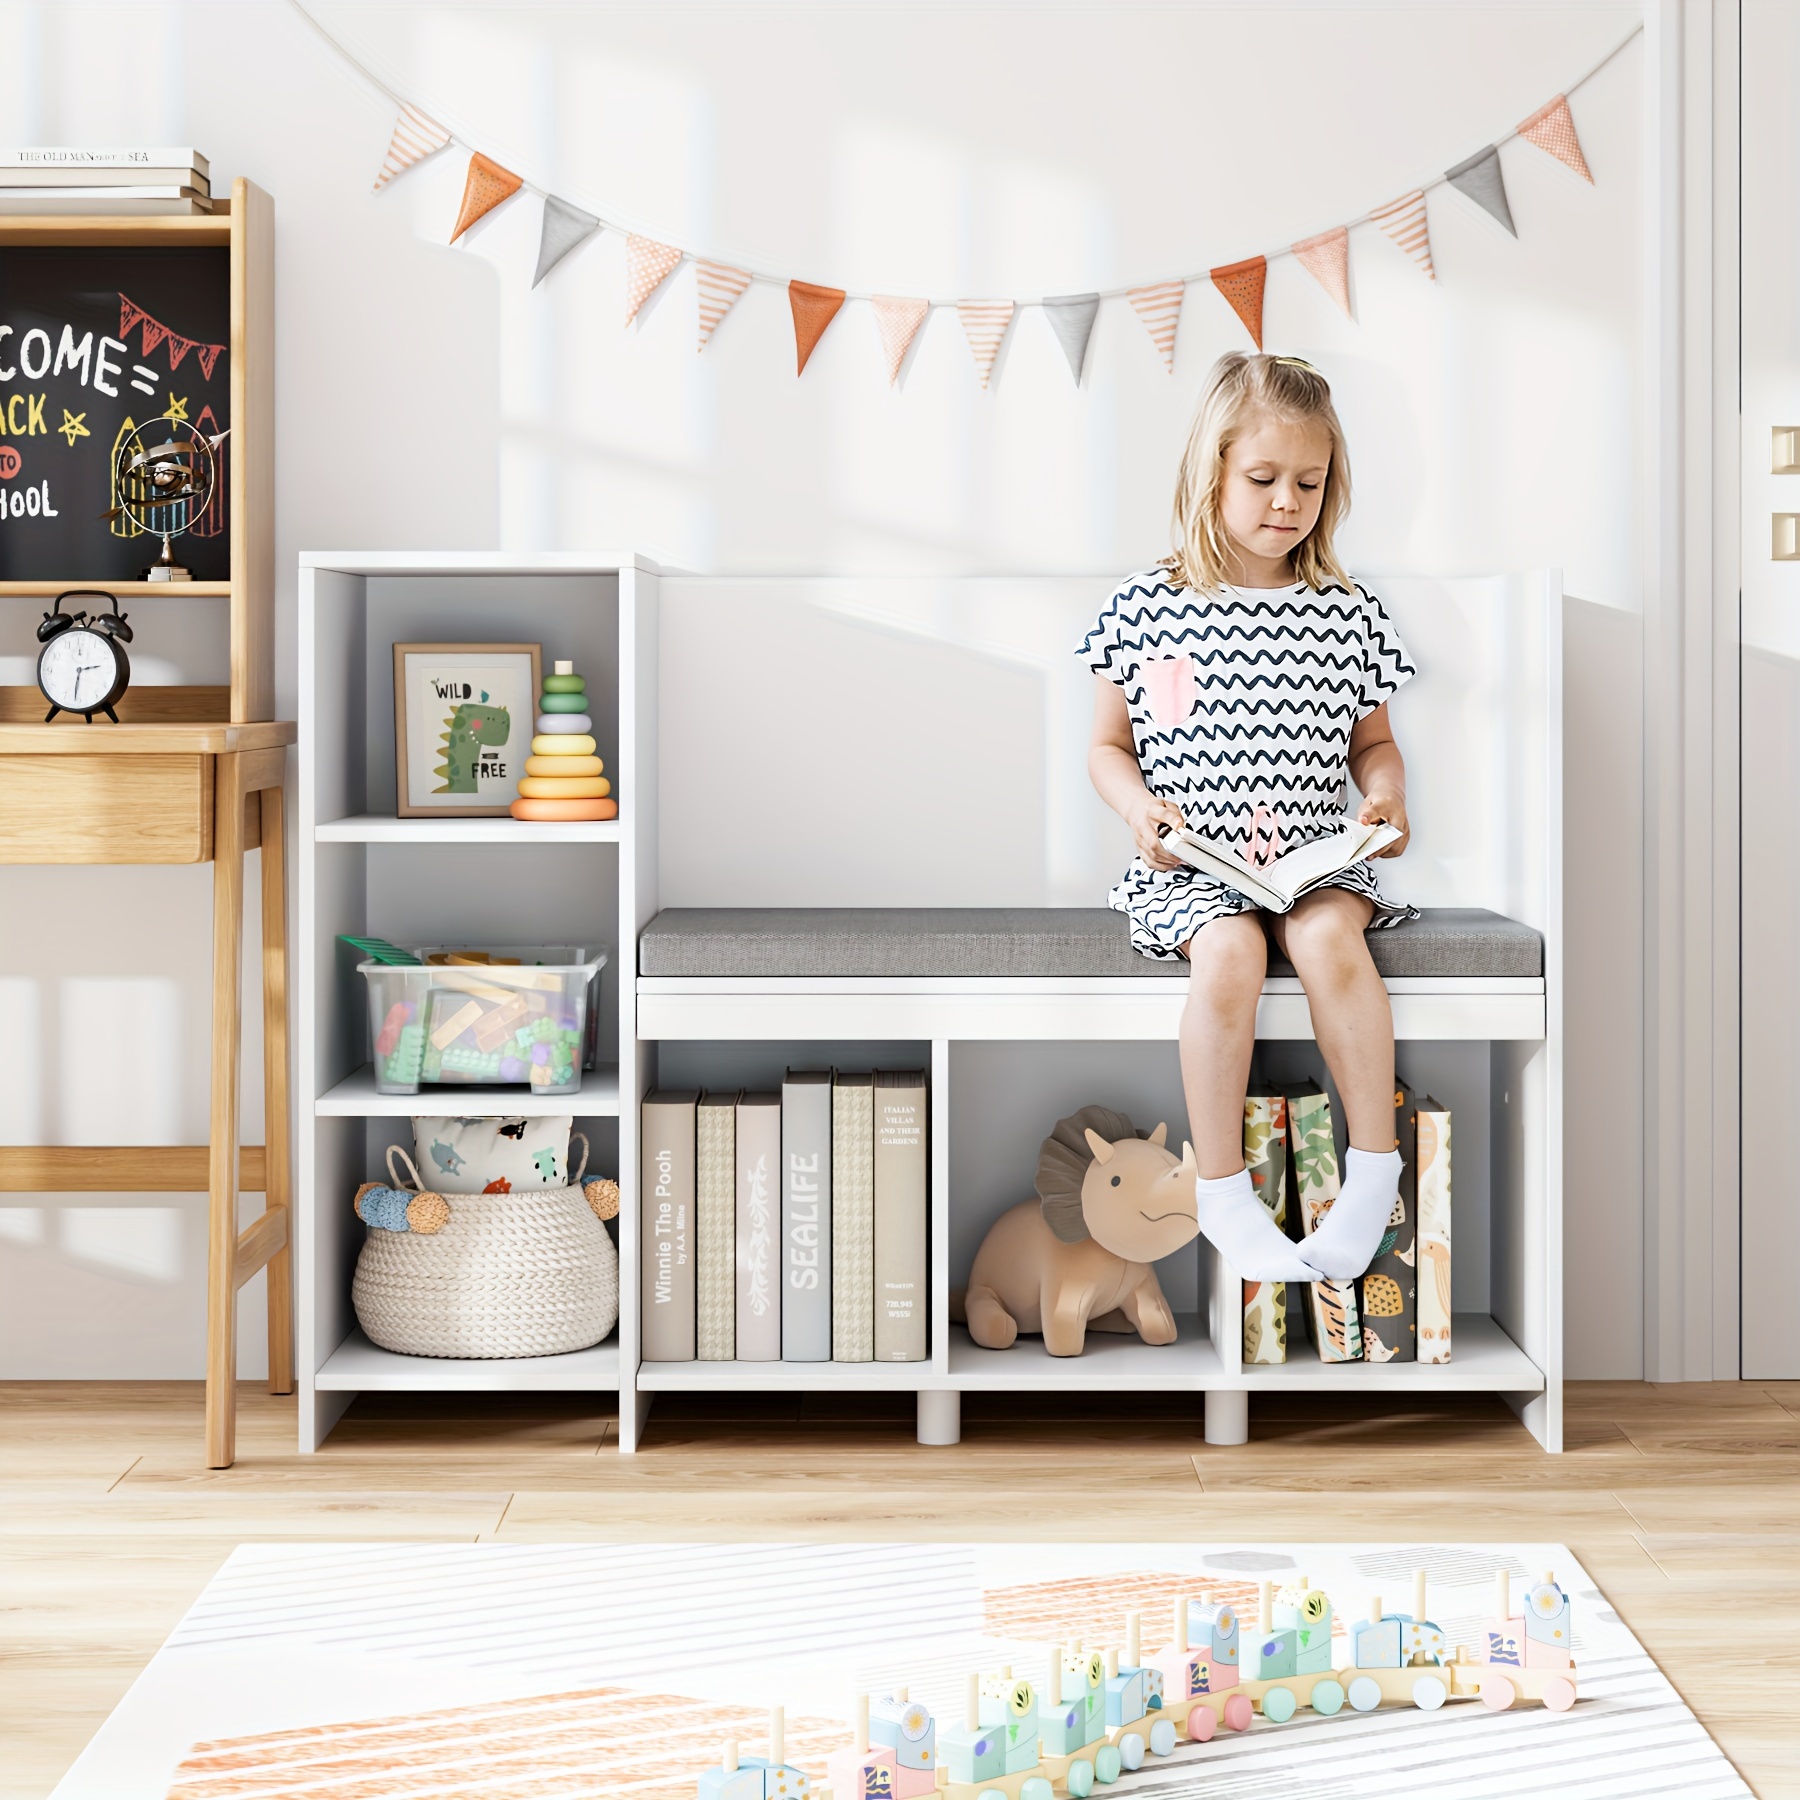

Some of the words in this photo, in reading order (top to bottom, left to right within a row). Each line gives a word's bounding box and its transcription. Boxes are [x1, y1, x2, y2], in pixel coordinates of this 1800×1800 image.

[18, 152, 40, 161] THE
[43, 152, 67, 161] OLD
[70, 152, 94, 161] MAN
[128, 152, 149, 161] SEA
[435, 683, 472, 700] WILD
[472, 763, 507, 779] FREE
[655, 1150, 672, 1197] Pooh
[655, 1202, 672, 1237] The
[676, 1204, 686, 1230] Milne
[790, 1153, 818, 1290] SEALIFE
[676, 1233, 686, 1252] A.A.
[676, 1253, 687, 1265] by
[655, 1242, 672, 1304] Winnie
